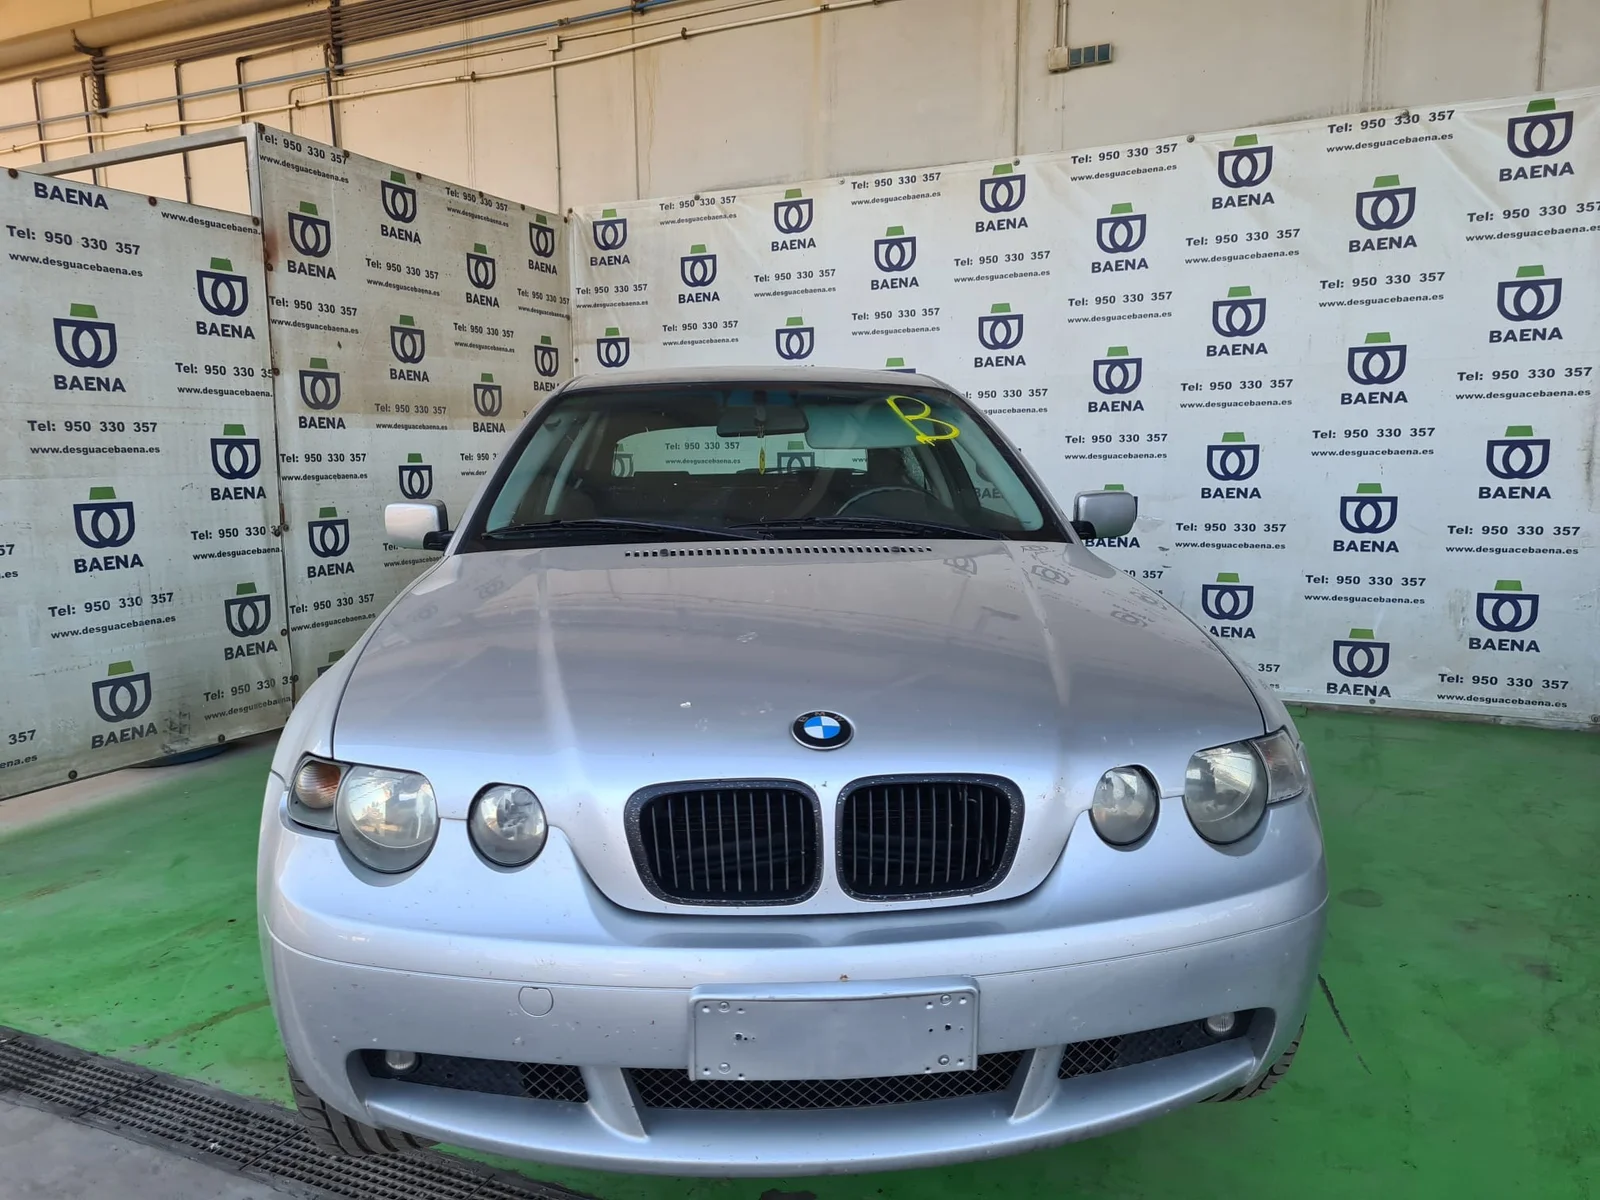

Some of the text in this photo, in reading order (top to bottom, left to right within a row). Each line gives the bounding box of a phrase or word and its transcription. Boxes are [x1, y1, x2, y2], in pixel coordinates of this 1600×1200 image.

[1328, 110, 1454, 133] Tel: 950 330 357
[258, 131, 347, 165] Tel: 950 330 357
[1327, 134, 1453, 152] www.desguacebaena.es
[1071, 143, 1177, 164] Tel: 950 330 357
[259, 154, 349, 183] www.desguacebaena.es
[1071, 165, 1177, 181] www.desguacebaena.es
[1499, 162, 1574, 182] BAENA
[851, 172, 941, 189] Tel: 950 330 357
[34, 182, 109, 210] BAENA
[679, 200, 695, 208] 950
[700, 198, 715, 206] 330
[721, 196, 736, 204] 357
[851, 192, 941, 205] www.desguacebaena.es
[1212, 192, 1274, 209] BAENA
[660, 213, 737, 225] www.desguacebaena.es
[976, 217, 1028, 232] BAENA
[6, 225, 140, 255] Tel: 950 330 357
[381, 222, 421, 244] BAENA
[1186, 229, 1300, 246] Tel: 950 330 357
[772, 238, 816, 251] BAENA
[1349, 235, 1417, 252] BAENA
[590, 255, 630, 266] BAENA
[954, 251, 1050, 266] Tel: 950 330 357
[1185, 250, 1299, 264] www.desguacebaena.es
[9, 254, 143, 277] www.desguacebaena.es
[288, 260, 336, 280] BAENA
[365, 258, 438, 279] Tel: 950 330 357
[529, 259, 557, 275] BAENA
[1092, 258, 1148, 273] BAENA
[871, 277, 919, 290] BAENA
[954, 271, 1050, 282] www.desguacebaena.es
[1320, 272, 1445, 289] Tel: 950 330 357
[367, 279, 440, 296] www.desguacebaena.es
[594, 286, 609, 294] 950
[614, 285, 629, 293] 330
[466, 292, 499, 308] BAENA
[679, 291, 720, 303] BAENA
[1319, 295, 1444, 307] www.desguacebaena.es
[269, 295, 357, 316] Tel: 950 330 357
[196, 321, 255, 339] BAENA
[271, 317, 358, 334] www.desguacebaena.es
[663, 324, 677, 332] Tel:
[723, 320, 738, 328] 357
[663, 338, 738, 346] www.desguacebaena.es
[1489, 327, 1563, 343] BAENA
[1207, 343, 1268, 357] BAENA
[975, 355, 1026, 368] BAENA
[390, 368, 429, 382] BAENA
[54, 375, 126, 392] BAENA
[1341, 391, 1408, 405] BAENA
[1088, 400, 1144, 412] BAENA
[27, 420, 157, 432] Tel: 950 330 357
[299, 416, 346, 429] BAENA
[473, 422, 505, 433] BAENA
[887, 395, 960, 446] B
[1065, 434, 1167, 443] Tel: 950 330 357
[1312, 428, 1435, 439] Tel: 950 330 357
[30, 445, 160, 455] www.desguacebaena.es
[685, 442, 700, 450] 950
[705, 442, 720, 450] 330
[1311, 449, 1434, 457] www.desguacebaena.es
[280, 453, 366, 463] Tel: 950 330 357
[282, 472, 367, 482] www.desguacebaena.es
[211, 486, 266, 500] BAENA
[1201, 488, 1261, 499] BAENA
[1479, 487, 1551, 499] BAENA
[1176, 523, 1286, 532] Tel: 950 330 357
[1333, 540, 1399, 552] BAENA
[74, 554, 144, 573] BAENA
[307, 562, 354, 578] BAENA
[1306, 575, 1426, 586] Tel: 950 330 357
[48, 592, 173, 617] Tel: 950 330 357
[290, 594, 374, 614] Tel: 950 330 357
[1305, 595, 1425, 604] www.desguacebaena.es
[51, 616, 176, 638] www.desguacebaena.es
[291, 612, 375, 632] www.desguacebaena.es
[224, 640, 278, 660] BAENA
[1469, 638, 1540, 652] BAENA
[1438, 674, 1568, 689] Tel: 950 330 357
[1327, 683, 1391, 697] BAENA
[1437, 695, 1567, 707] www.desguacebaena.es
[91, 721, 157, 749] BAENA
